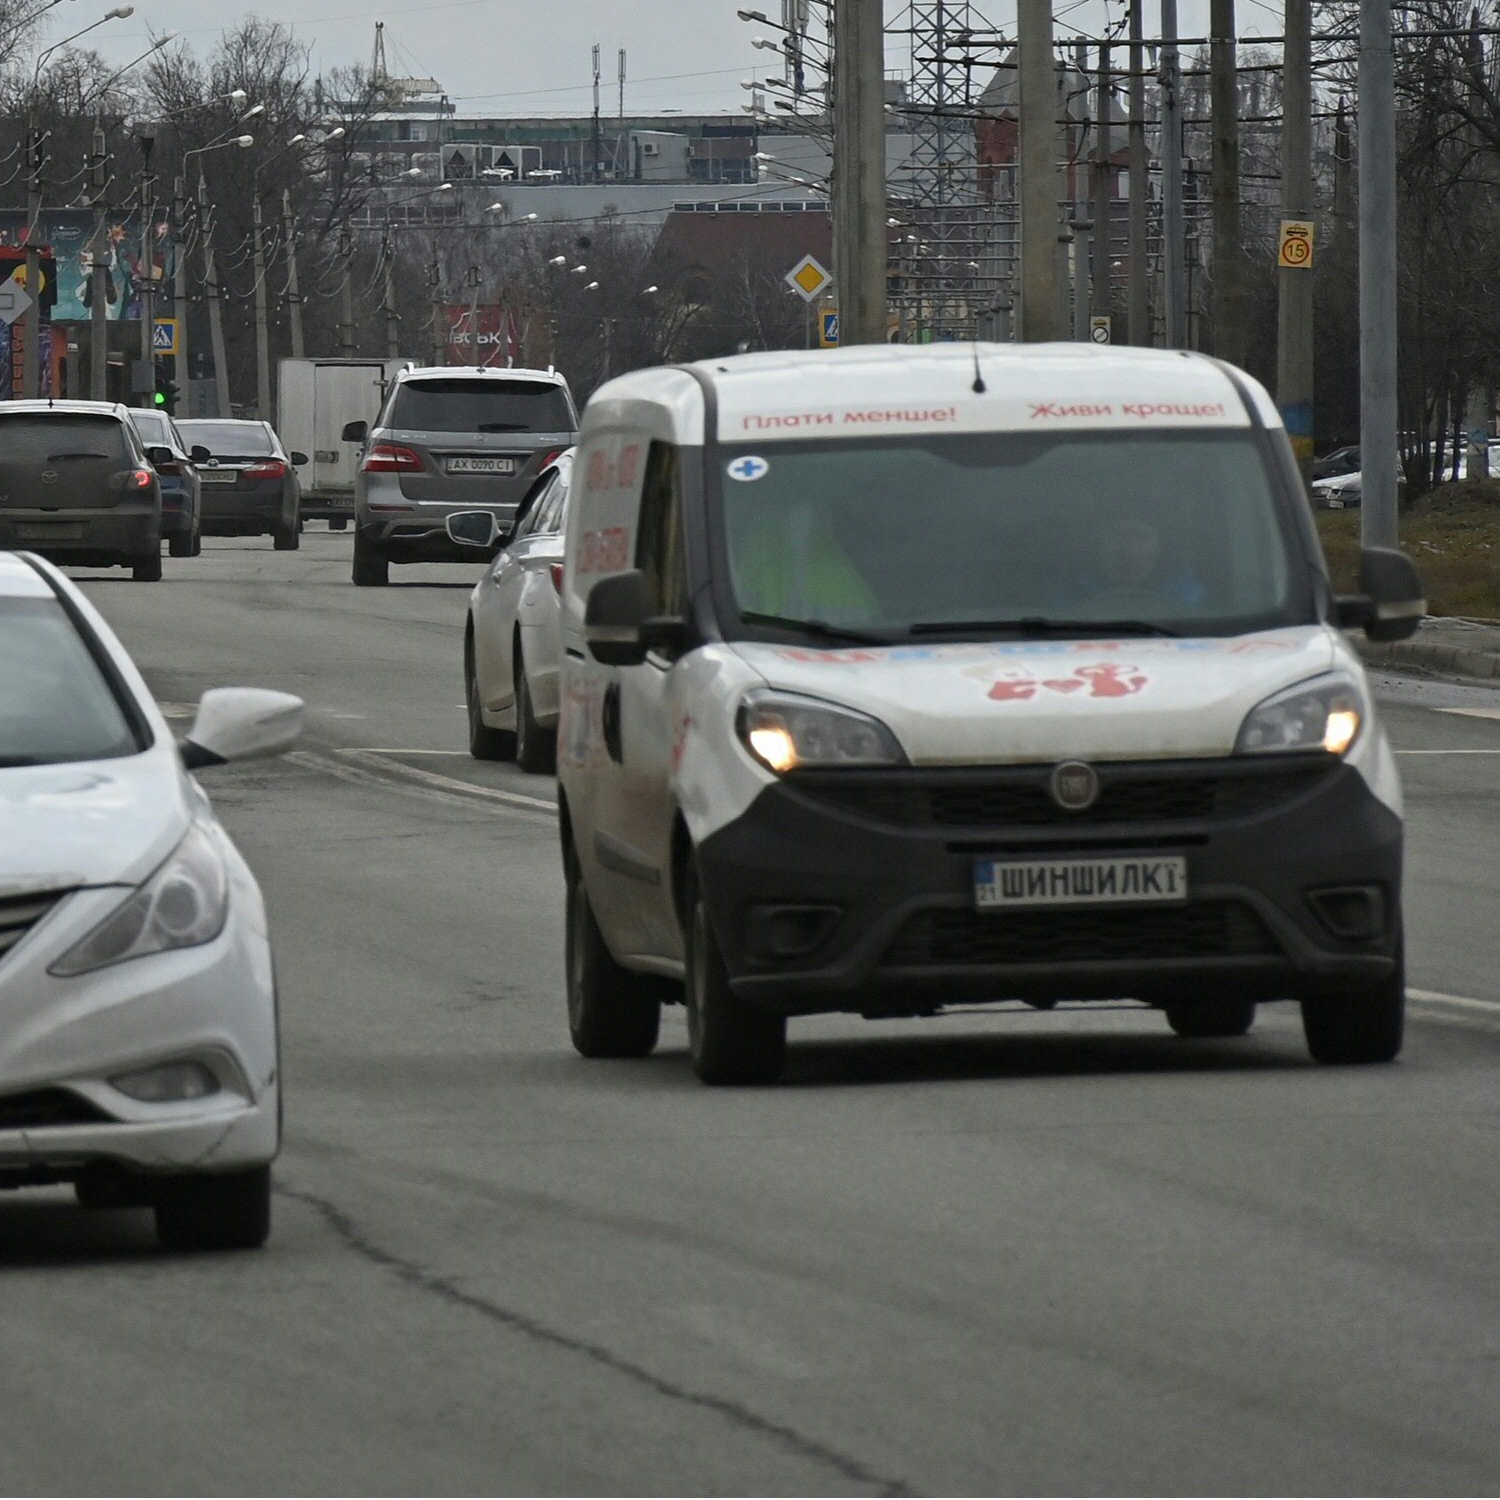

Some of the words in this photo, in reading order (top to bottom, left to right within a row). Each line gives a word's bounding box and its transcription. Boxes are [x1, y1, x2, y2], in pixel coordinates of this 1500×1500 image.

[1288, 243, 1305, 259] 15
[742, 413, 833, 430] Плати
[843, 407, 956, 425] менше!
[1027, 402, 1112, 419] Живи
[1122, 401, 1225, 420] краще!
[454, 460, 468, 470] AX
